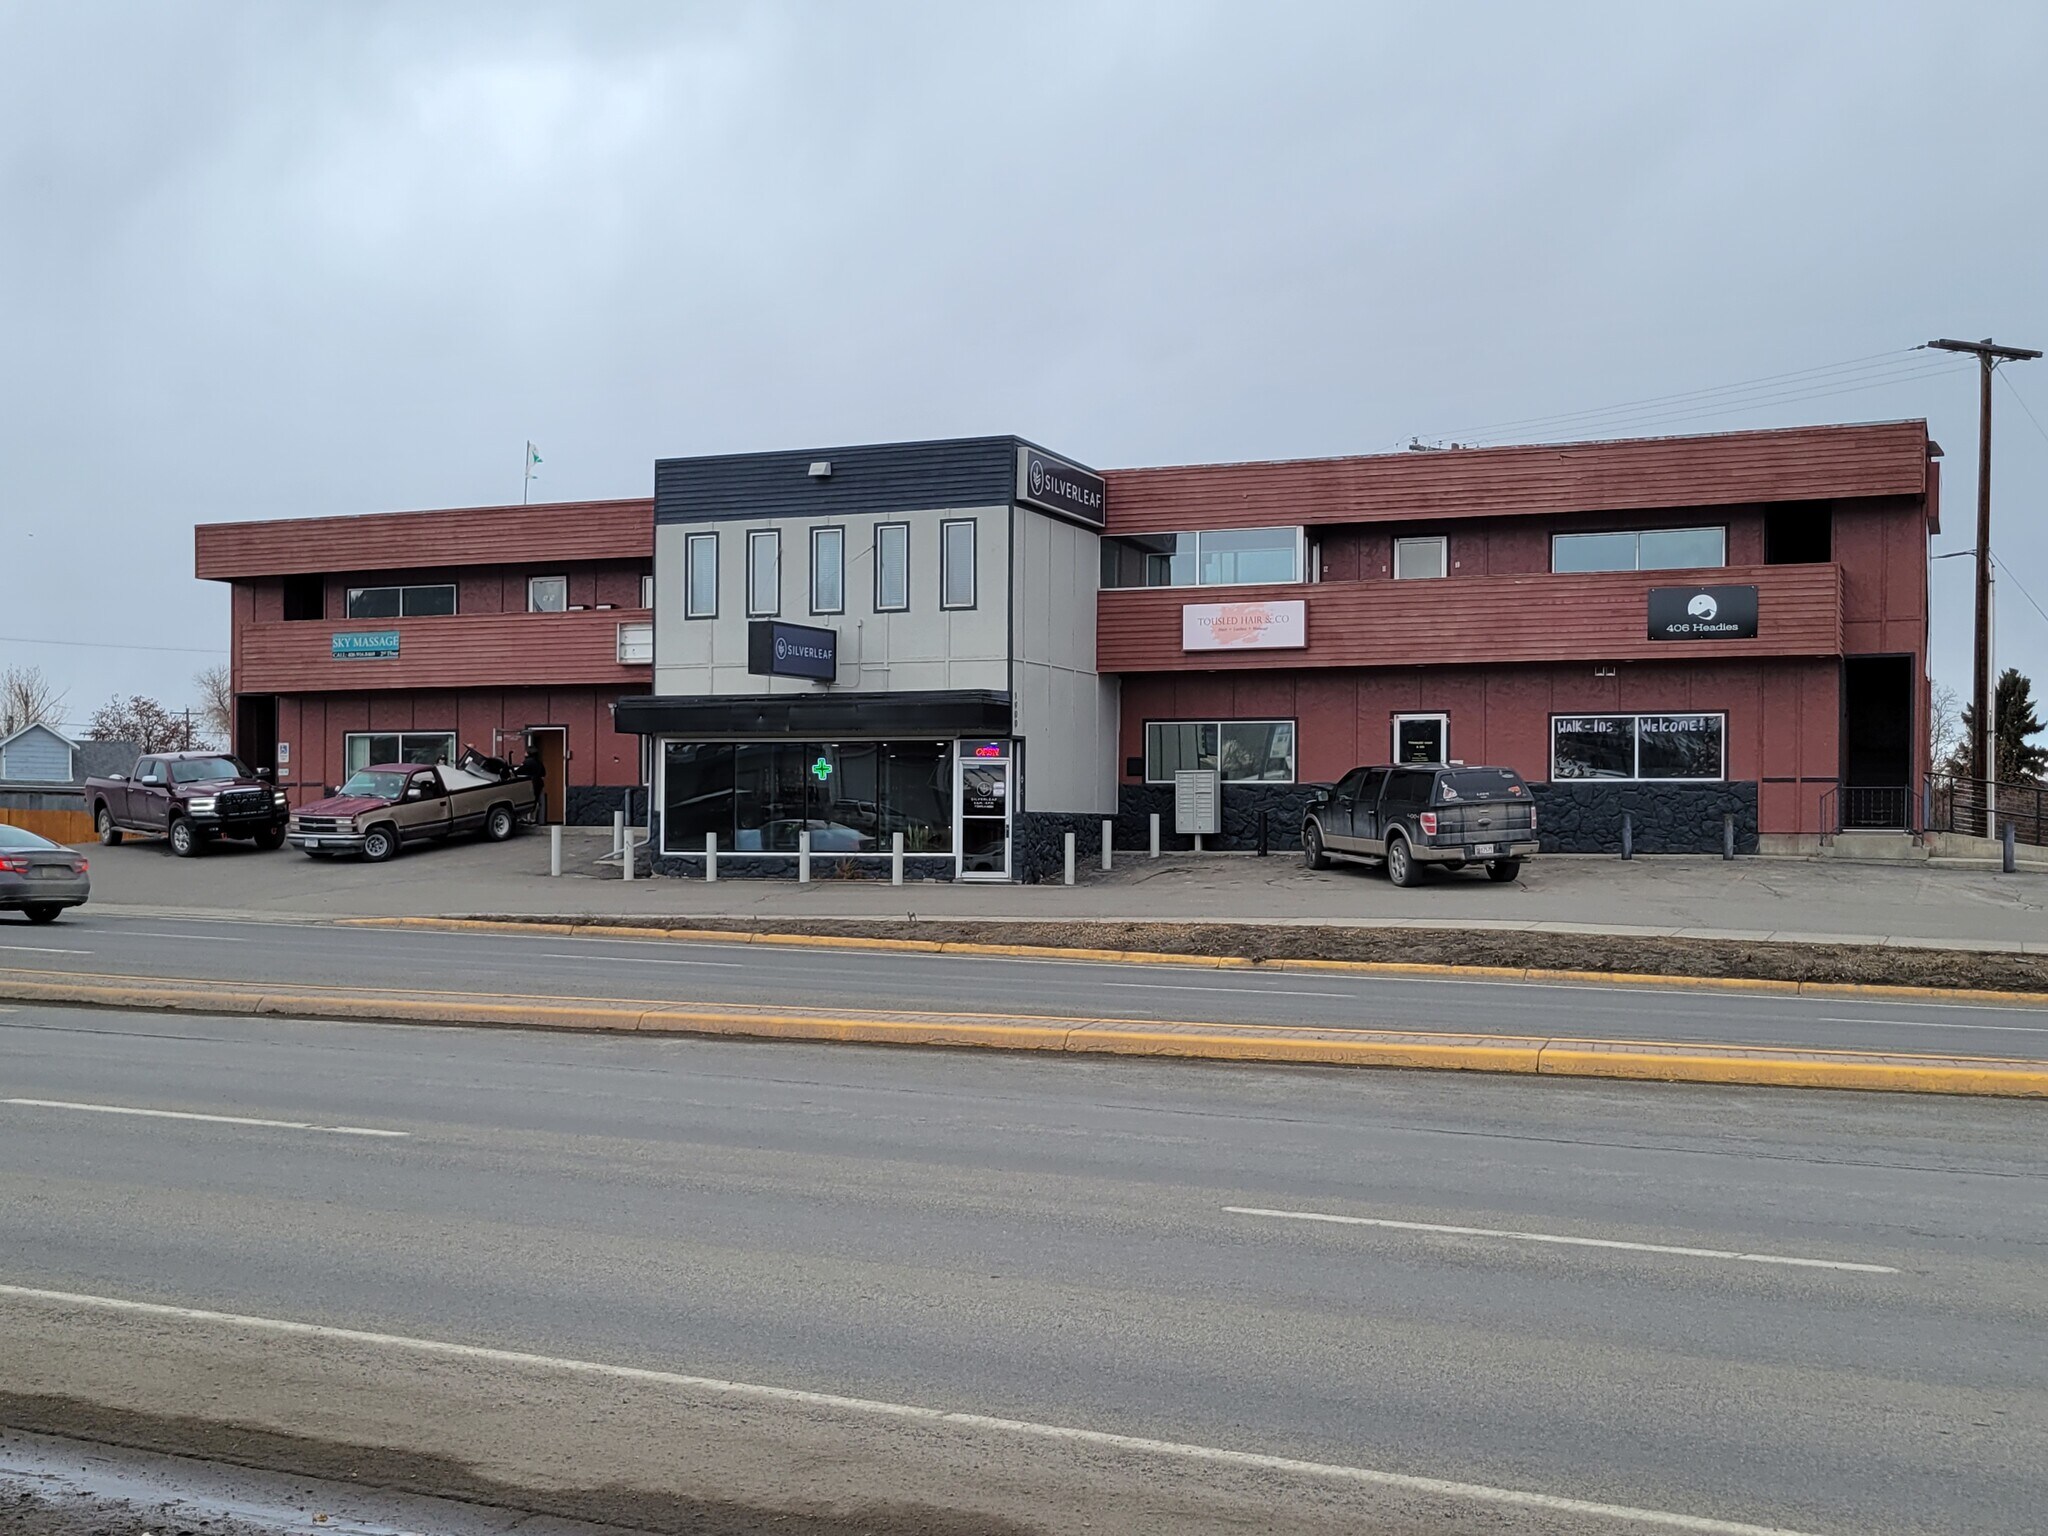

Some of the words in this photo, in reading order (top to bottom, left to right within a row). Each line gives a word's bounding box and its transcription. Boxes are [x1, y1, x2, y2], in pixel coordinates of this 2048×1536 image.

[1045, 474, 1101, 508] SILVERLEAF
[1197, 616, 1238, 626] TOUSLED
[1240, 615, 1263, 625] HAIR
[1265, 615, 1273, 624] &
[1275, 615, 1290, 624] CO
[1666, 623, 1690, 632] 406
[1693, 622, 1739, 632] Headies
[332, 637, 351, 648] SKY
[353, 635, 399, 648] MASSAGE
[787, 645, 833, 660] SILVERLEAF
[975, 747, 1000, 757] OPEN
